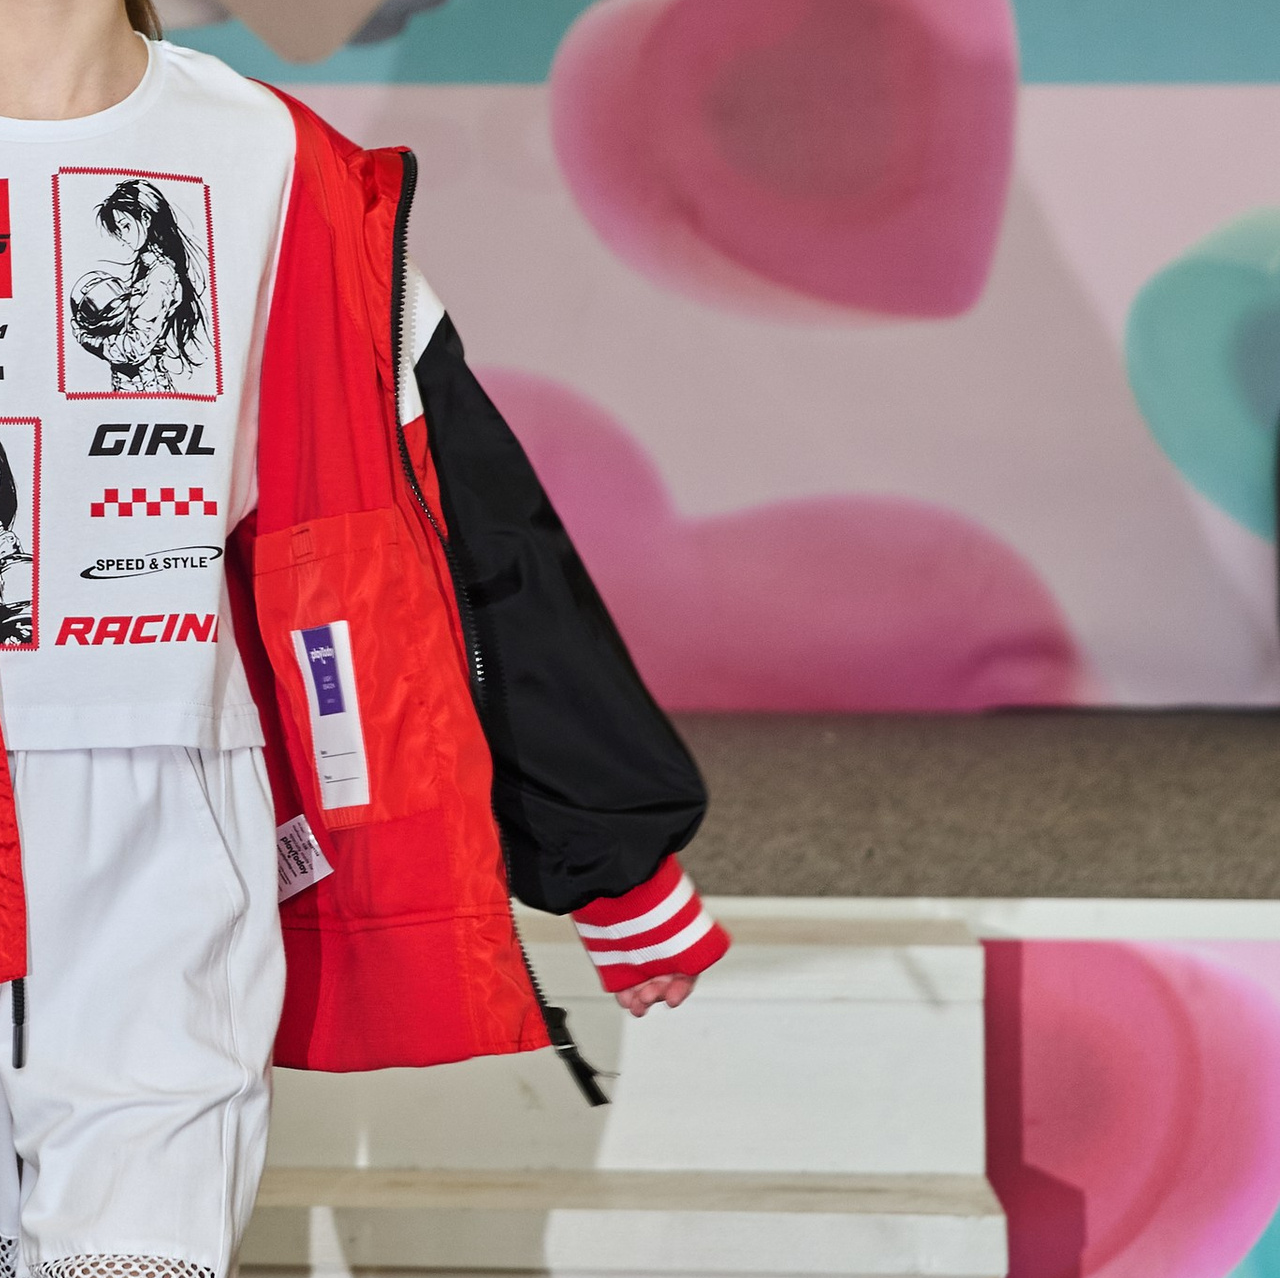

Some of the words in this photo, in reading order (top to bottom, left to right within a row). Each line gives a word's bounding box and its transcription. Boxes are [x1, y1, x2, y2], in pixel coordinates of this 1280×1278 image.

[88, 423, 216, 457] GIRL
[96, 558, 145, 572] SPEED
[149, 558, 159, 570] &
[163, 556, 208, 569] STYLE
[55, 613, 219, 646] RACIN
